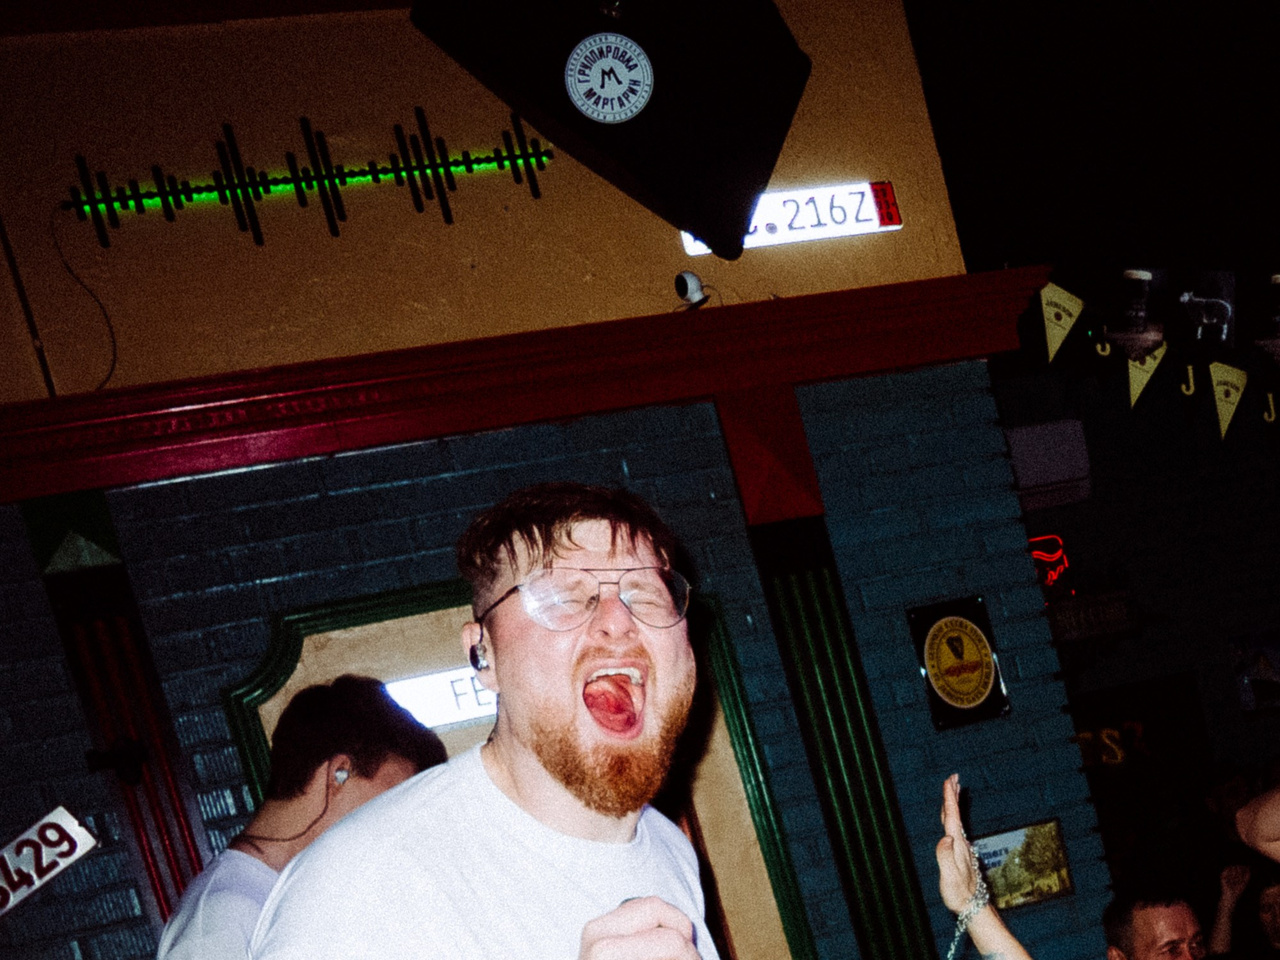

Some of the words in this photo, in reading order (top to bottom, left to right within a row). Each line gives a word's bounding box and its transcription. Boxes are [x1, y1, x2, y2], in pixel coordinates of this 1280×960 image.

[577, 44, 639, 84] ГРУППИРОВКА
[582, 78, 642, 112] МАРГАРИН
[1181, 365, 1195, 395] J
[1263, 393, 1276, 423] J
